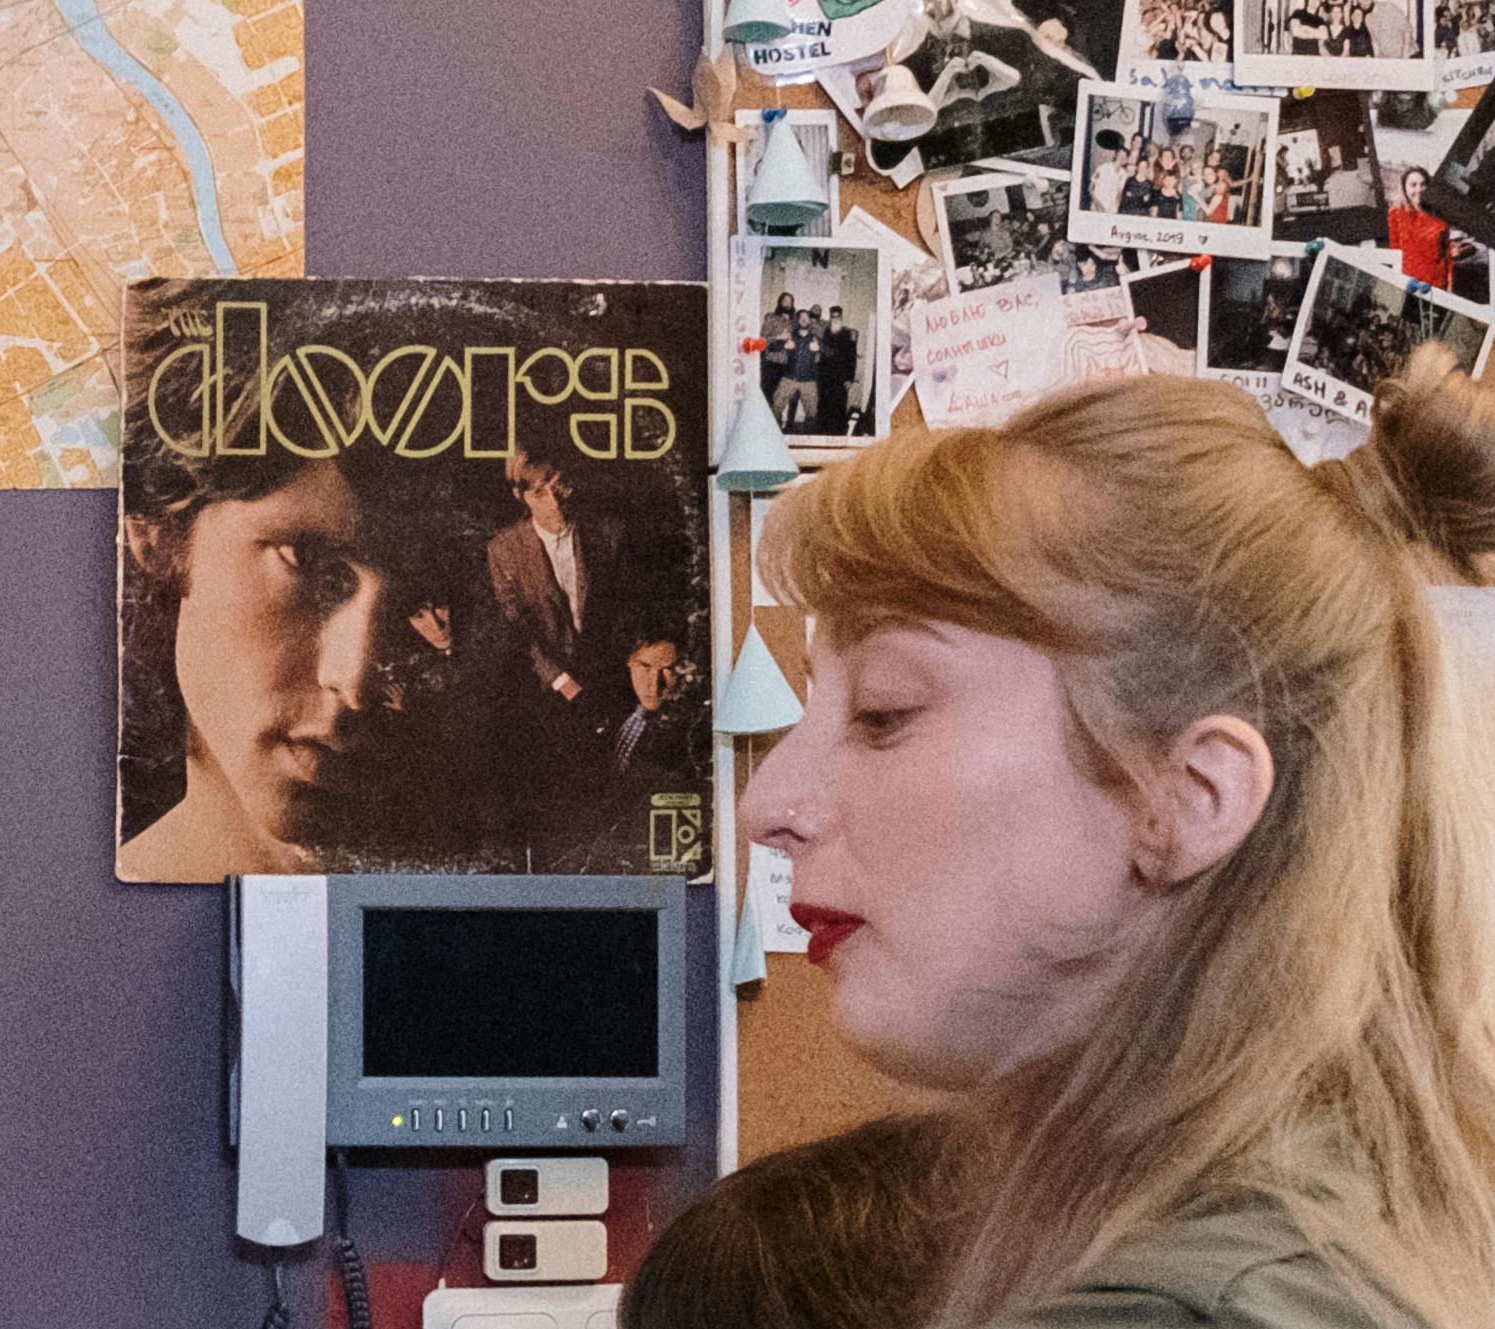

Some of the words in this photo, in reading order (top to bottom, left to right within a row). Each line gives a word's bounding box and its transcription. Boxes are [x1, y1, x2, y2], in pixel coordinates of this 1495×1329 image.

[753, 41, 832, 65] HOSTEL
[1293, 372, 1327, 399] ASH
[1333, 390, 1348, 407] &
